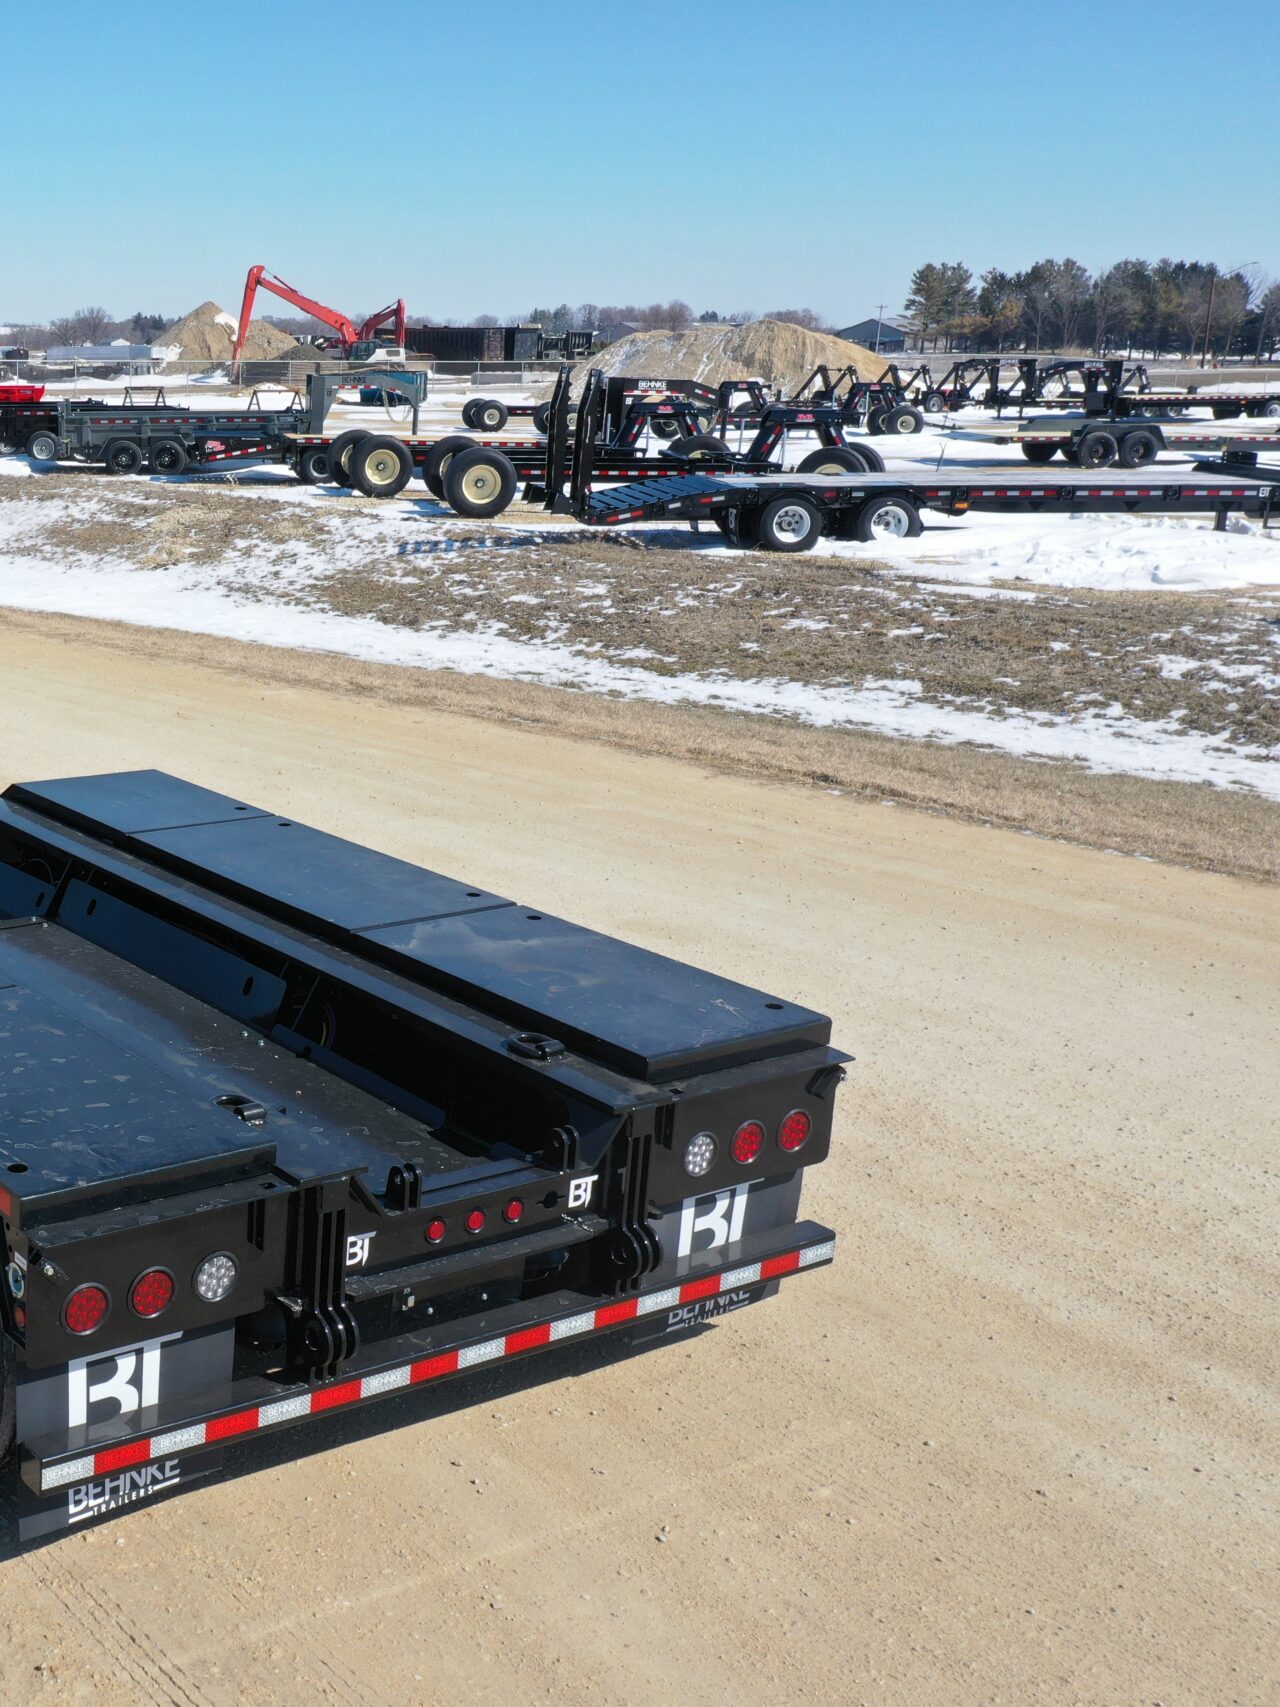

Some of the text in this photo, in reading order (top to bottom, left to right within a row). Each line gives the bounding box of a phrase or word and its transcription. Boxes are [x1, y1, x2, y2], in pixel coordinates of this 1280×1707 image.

[341, 376, 367, 384] BEHNKE
[638, 380, 667, 388] BEHNKE
[1258, 486, 1272, 498] BT
[567, 1174, 598, 1208] BT
[346, 1231, 377, 1267] BT
[370, 1372, 402, 1388] BEHNKE
[268, 1400, 303, 1417] BEHNKE
[160, 1430, 196, 1448] BEHNKE
[46, 1461, 84, 1480] BEHNKE
[69, 1458, 181, 1515] BEHNKE
[93, 1486, 154, 1516] TRAILERS
